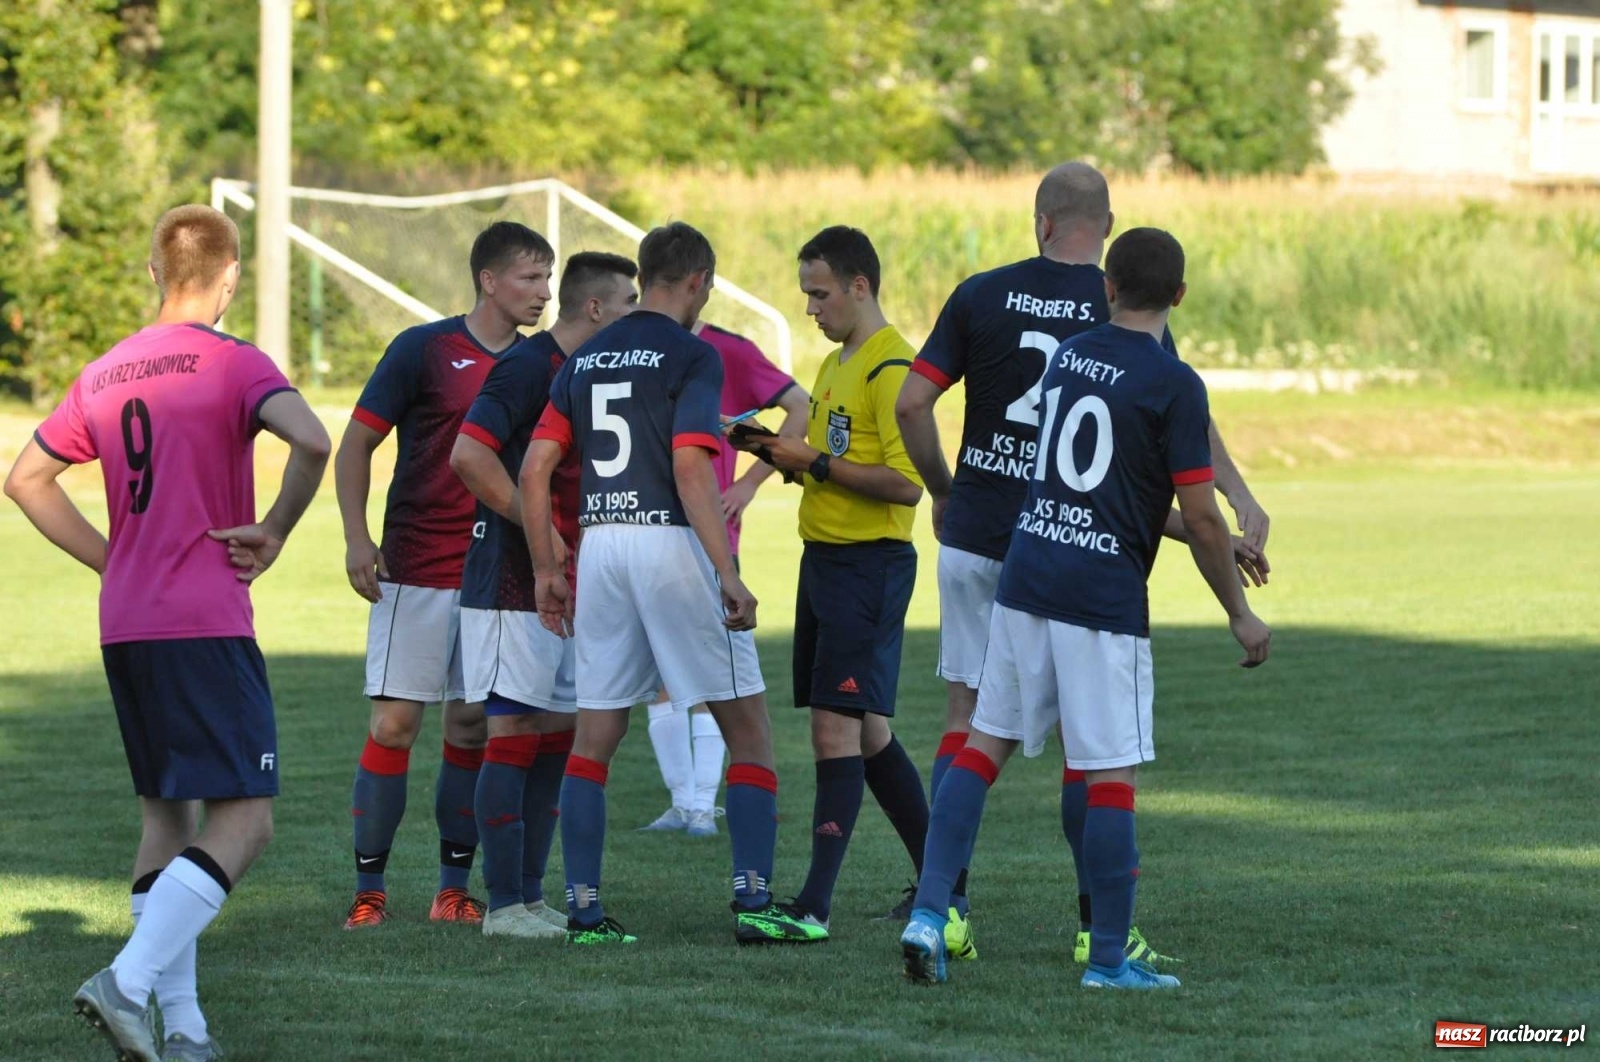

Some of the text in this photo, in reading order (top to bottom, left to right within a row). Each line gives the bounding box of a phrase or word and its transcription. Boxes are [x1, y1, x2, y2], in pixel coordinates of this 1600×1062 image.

[1005, 291, 1096, 322] HERBER S.
[574, 350, 665, 375] PIECZAREK
[1005, 330, 1060, 427] 2
[1058, 348, 1126, 386] ŚWIĘTY
[591, 381, 632, 478] 5
[991, 432, 1037, 460] KS 19
[1034, 385, 1114, 493] 10
[121, 397, 153, 515] 9
[962, 445, 1034, 481] KRZANO
[586, 491, 639, 512] KS 1905
[1033, 497, 1093, 529] KS 1905
